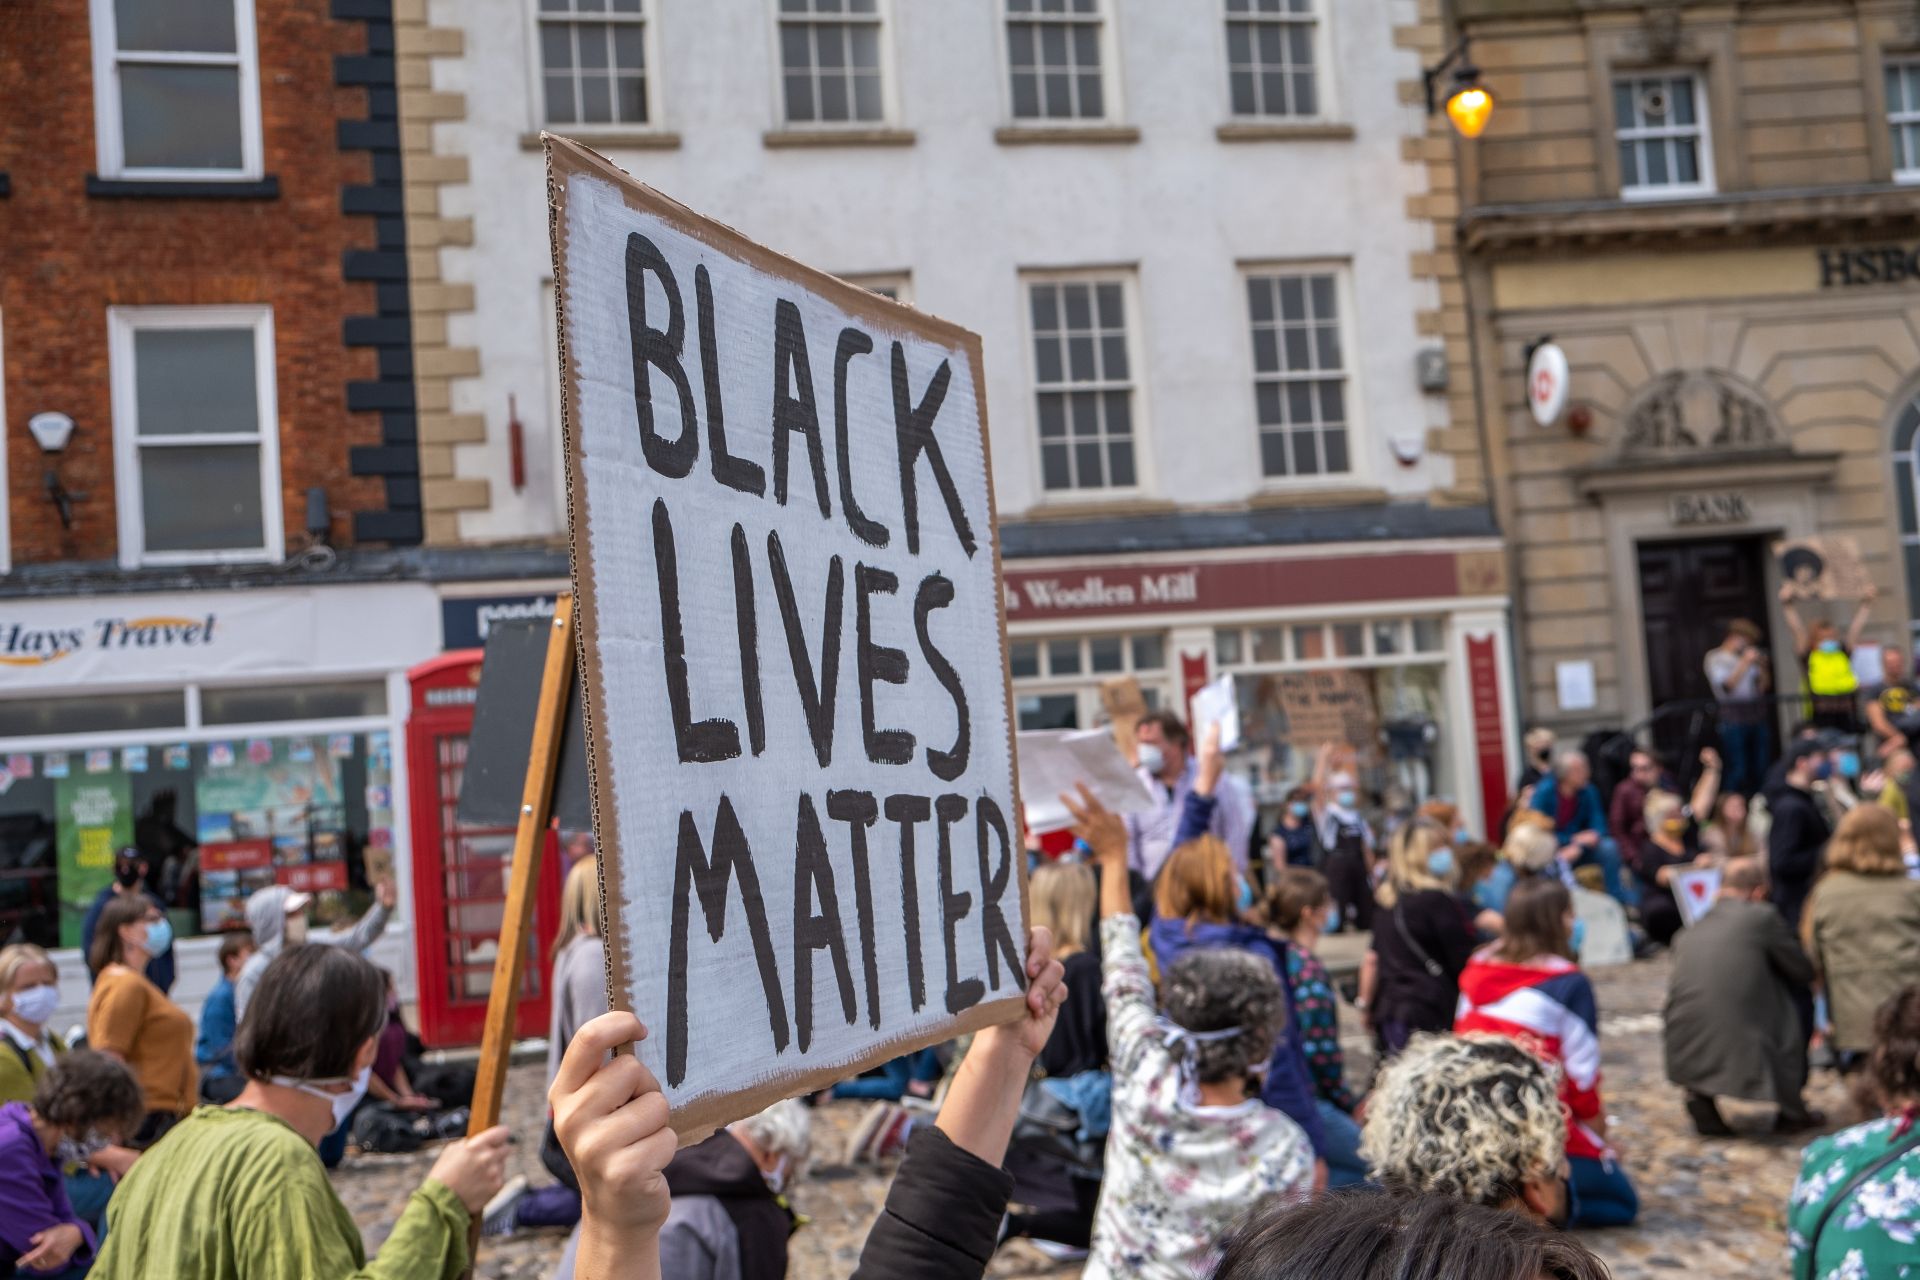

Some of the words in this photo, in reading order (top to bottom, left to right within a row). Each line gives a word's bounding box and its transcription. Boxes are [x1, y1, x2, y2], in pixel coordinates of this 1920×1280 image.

[625, 231, 978, 560] BLACK
[94, 613, 215, 648] Travel
[652, 497, 971, 782] LIVES
[1023, 577, 1135, 610] Woollen
[1141, 572, 1197, 603] Mill
[666, 787, 1027, 1088] MATTER
